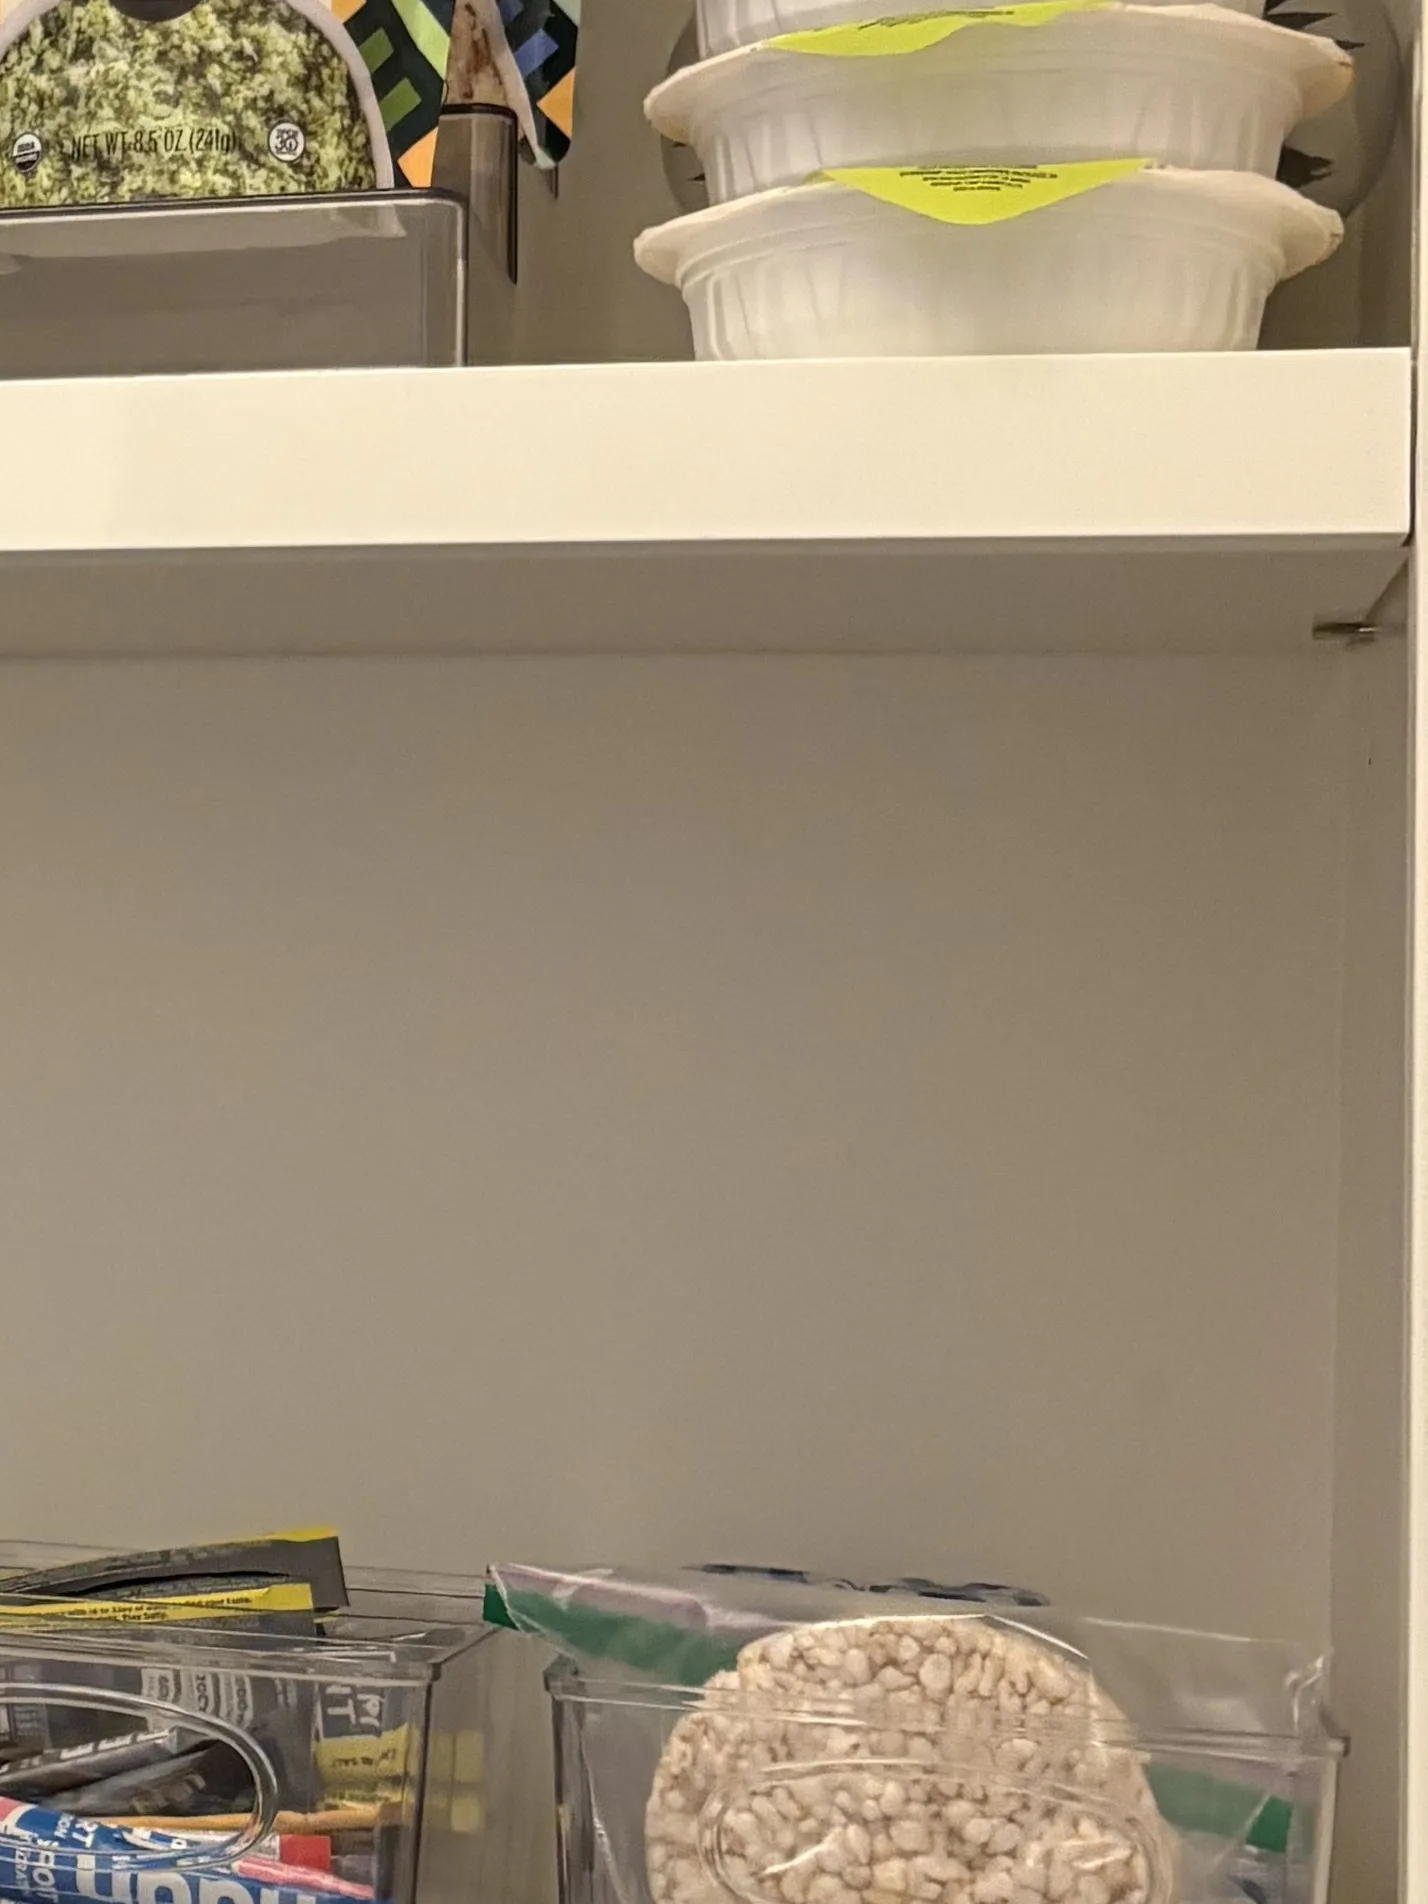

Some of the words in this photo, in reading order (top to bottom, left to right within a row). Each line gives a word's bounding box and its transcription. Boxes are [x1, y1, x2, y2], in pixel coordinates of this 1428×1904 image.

[71, 134, 99, 163] NET
[104, 132, 129, 160] WT
[163, 131, 184, 154] OZ
